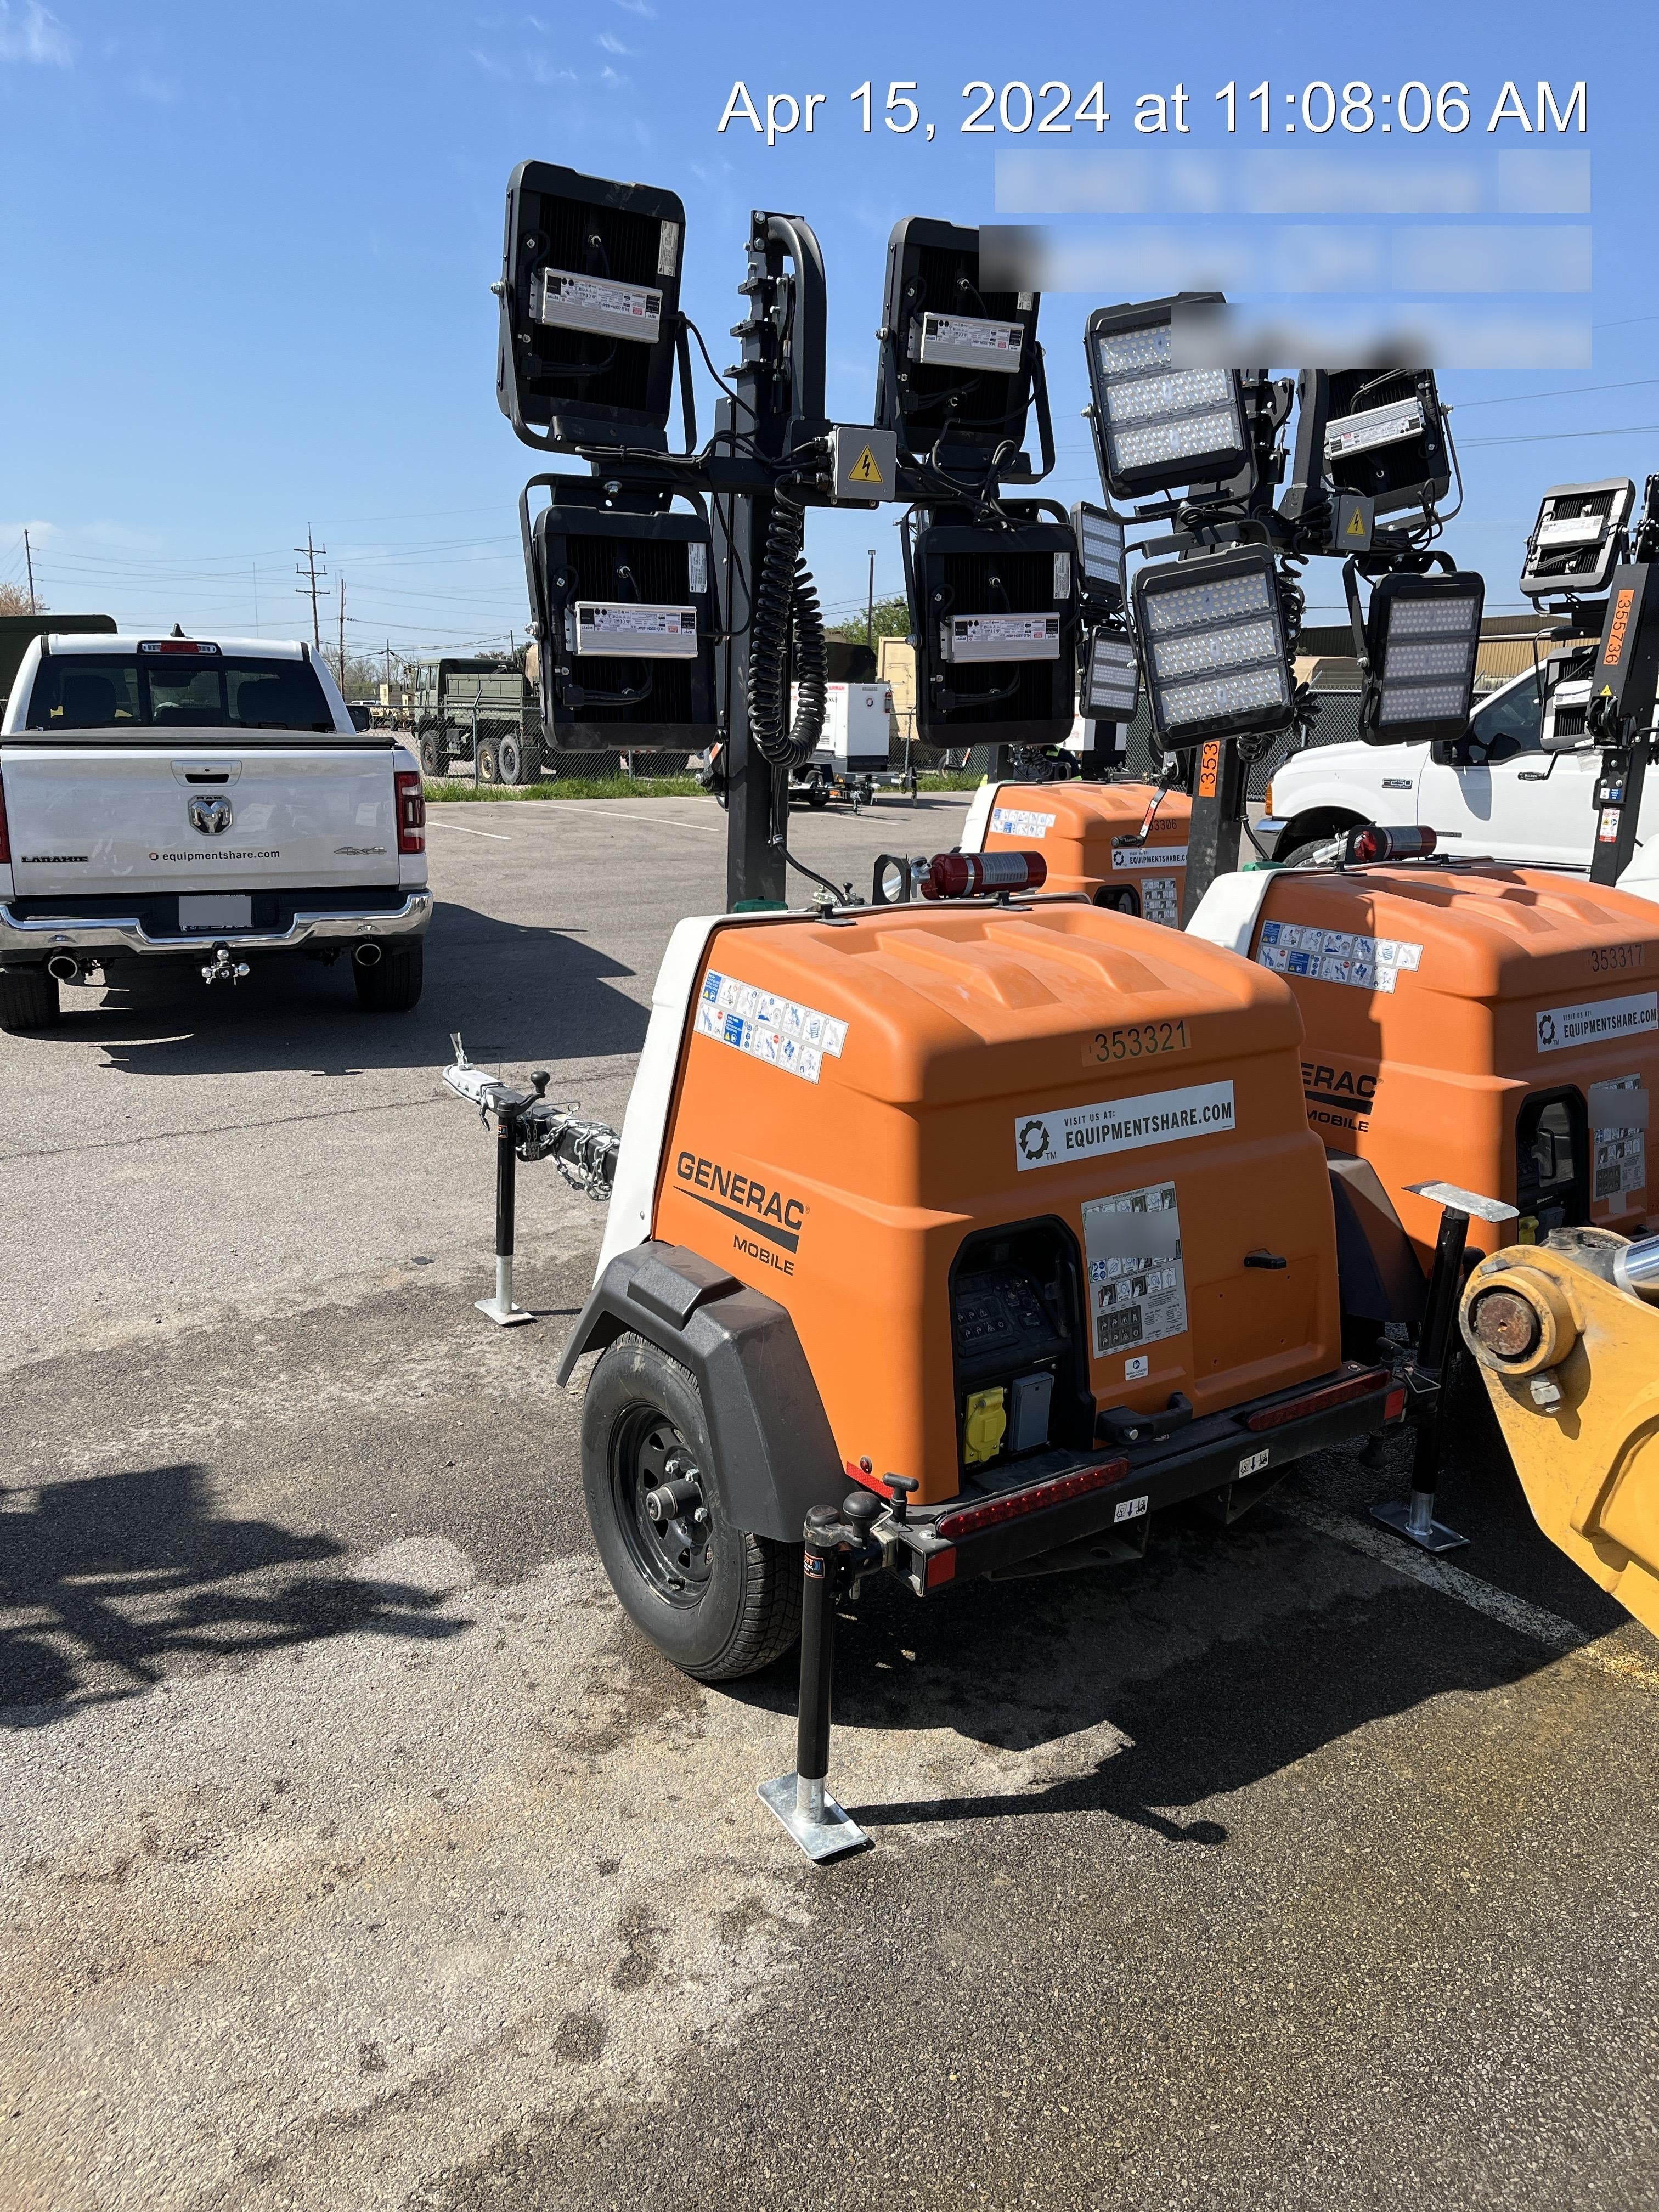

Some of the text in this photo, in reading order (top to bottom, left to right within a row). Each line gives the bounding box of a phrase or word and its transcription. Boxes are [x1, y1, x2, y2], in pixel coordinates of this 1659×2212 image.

[1605, 600, 1631, 663] 355736
[1201, 743, 1218, 785] 353
[1149, 819, 1177, 831] 3306
[162, 850, 280, 862] equipmentshare.com
[334, 847, 387, 855] 4x4
[1130, 854, 1187, 864] EQUIPMENTSHARE.C
[1591, 944, 1642, 972] 353317
[1563, 1013, 1575, 1021] VISIT
[1564, 1008, 1657, 1038] EQUIPMENTSHARE.COM
[1094, 1020, 1187, 1062] 353321
[1301, 1062, 1378, 1098] ERAC
[1063, 1110, 1116, 1127] VISIT US AT:
[1065, 1102, 1232, 1149] EQUIPMENTSHARE.COM
[1307, 1109, 1369, 1133] MOBILE
[1045, 1152, 1057, 1160] TM
[677, 1151, 804, 1231] GENERAC
[733, 1235, 794, 1277] MOBILE
